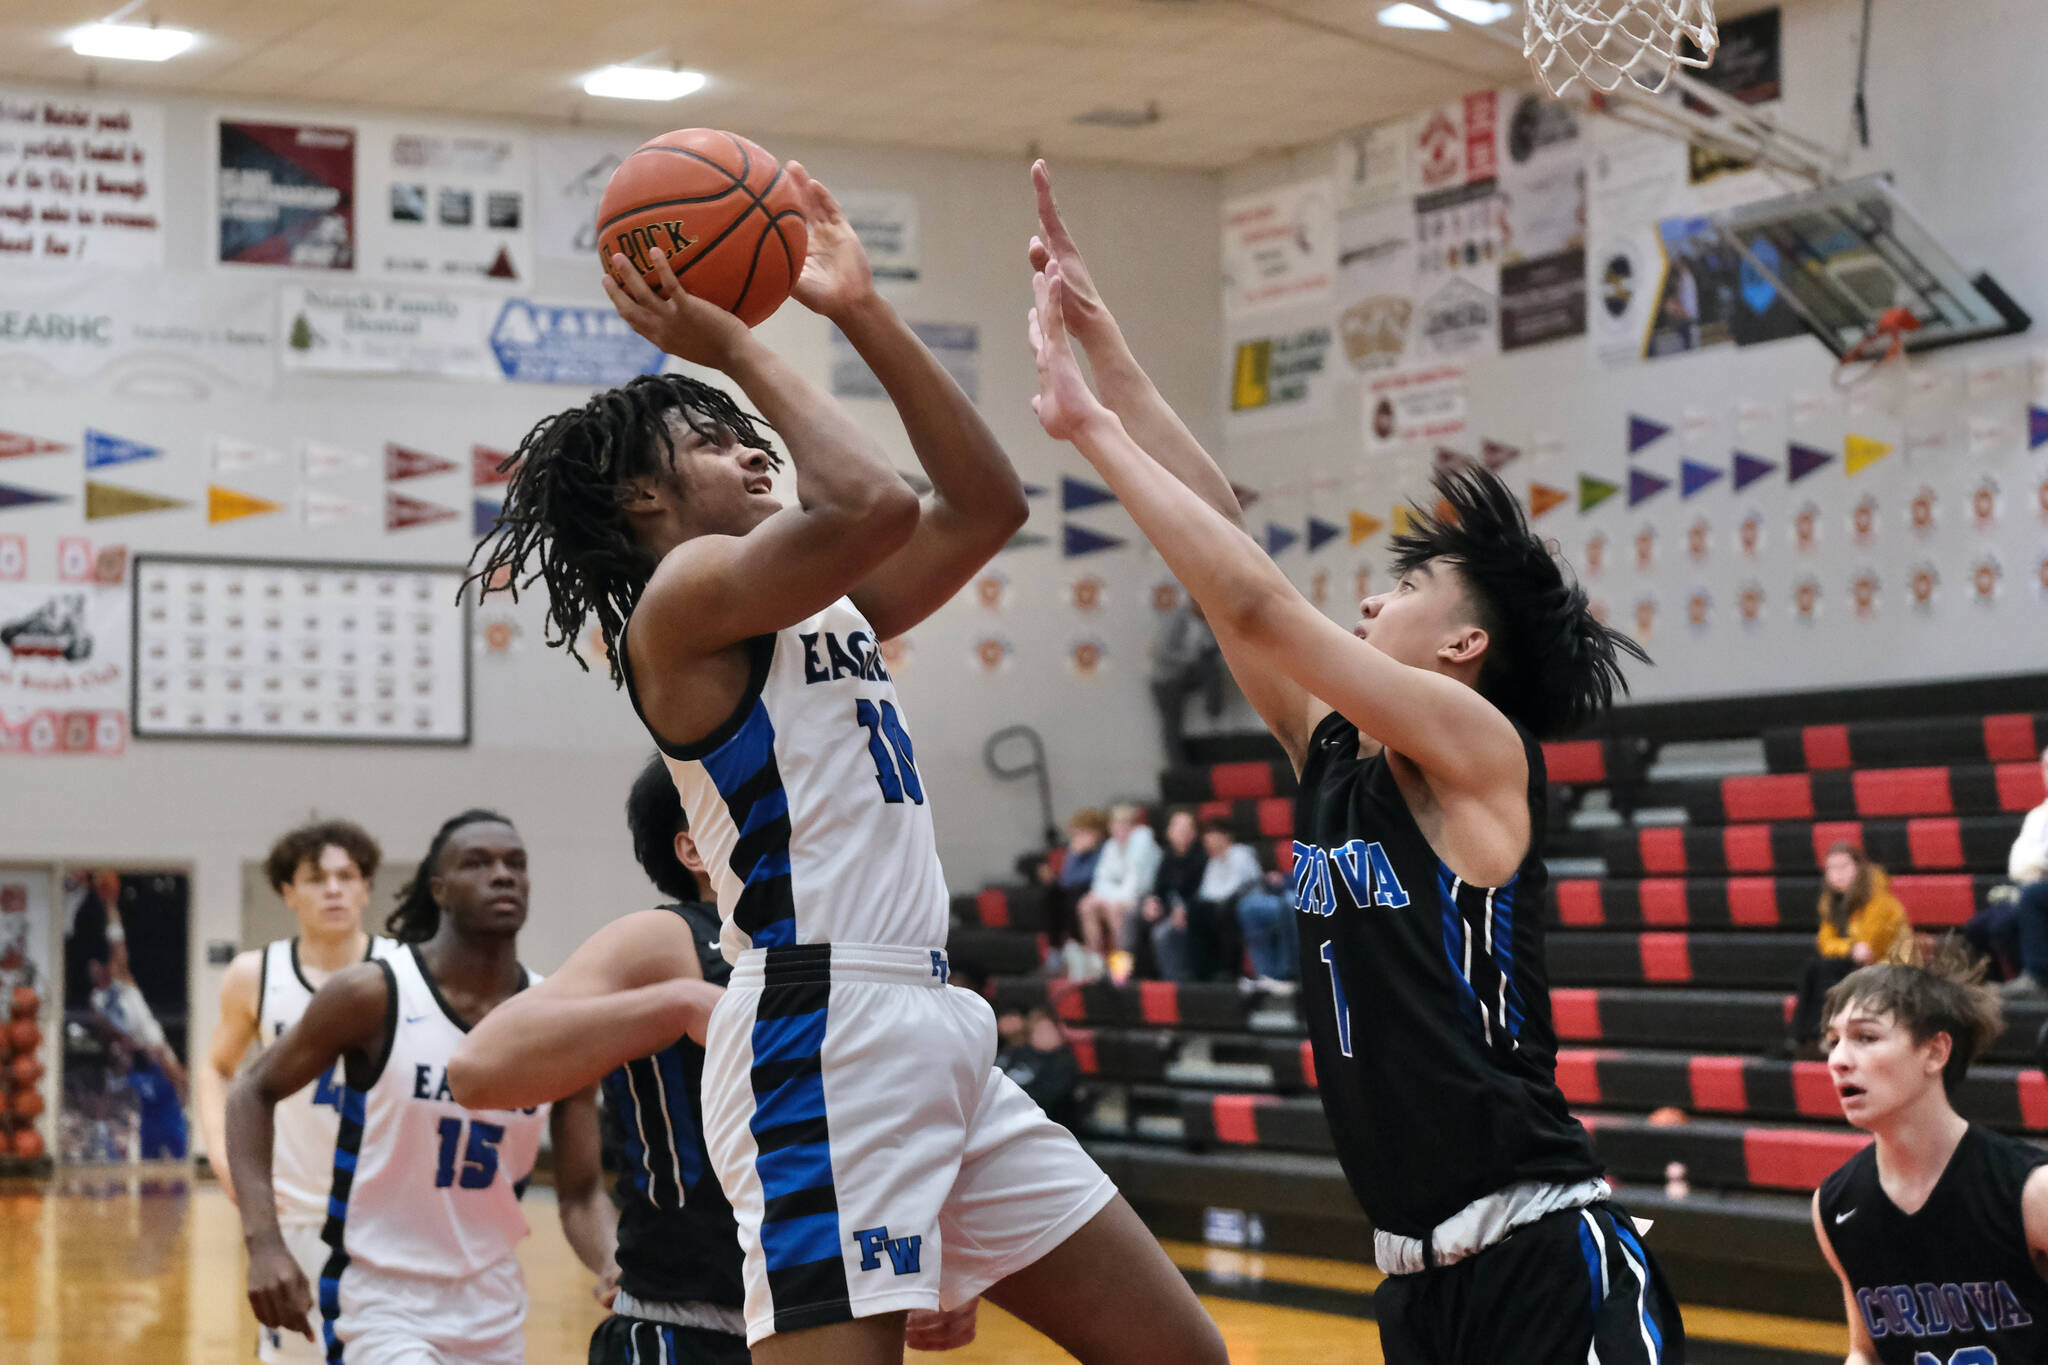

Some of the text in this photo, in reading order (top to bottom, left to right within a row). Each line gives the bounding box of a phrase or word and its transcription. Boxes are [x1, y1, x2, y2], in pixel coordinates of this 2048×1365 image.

[616, 220, 692, 275] ROCK
[0, 310, 111, 346] EARHC
[799, 631, 893, 686] EAGLE
[855, 698, 924, 805] 10
[1320, 939, 1353, 1058] 1
[436, 1116, 505, 1189] 15
[853, 1226, 922, 1276] FW
[1856, 1280, 2033, 1339] CORDOVA
